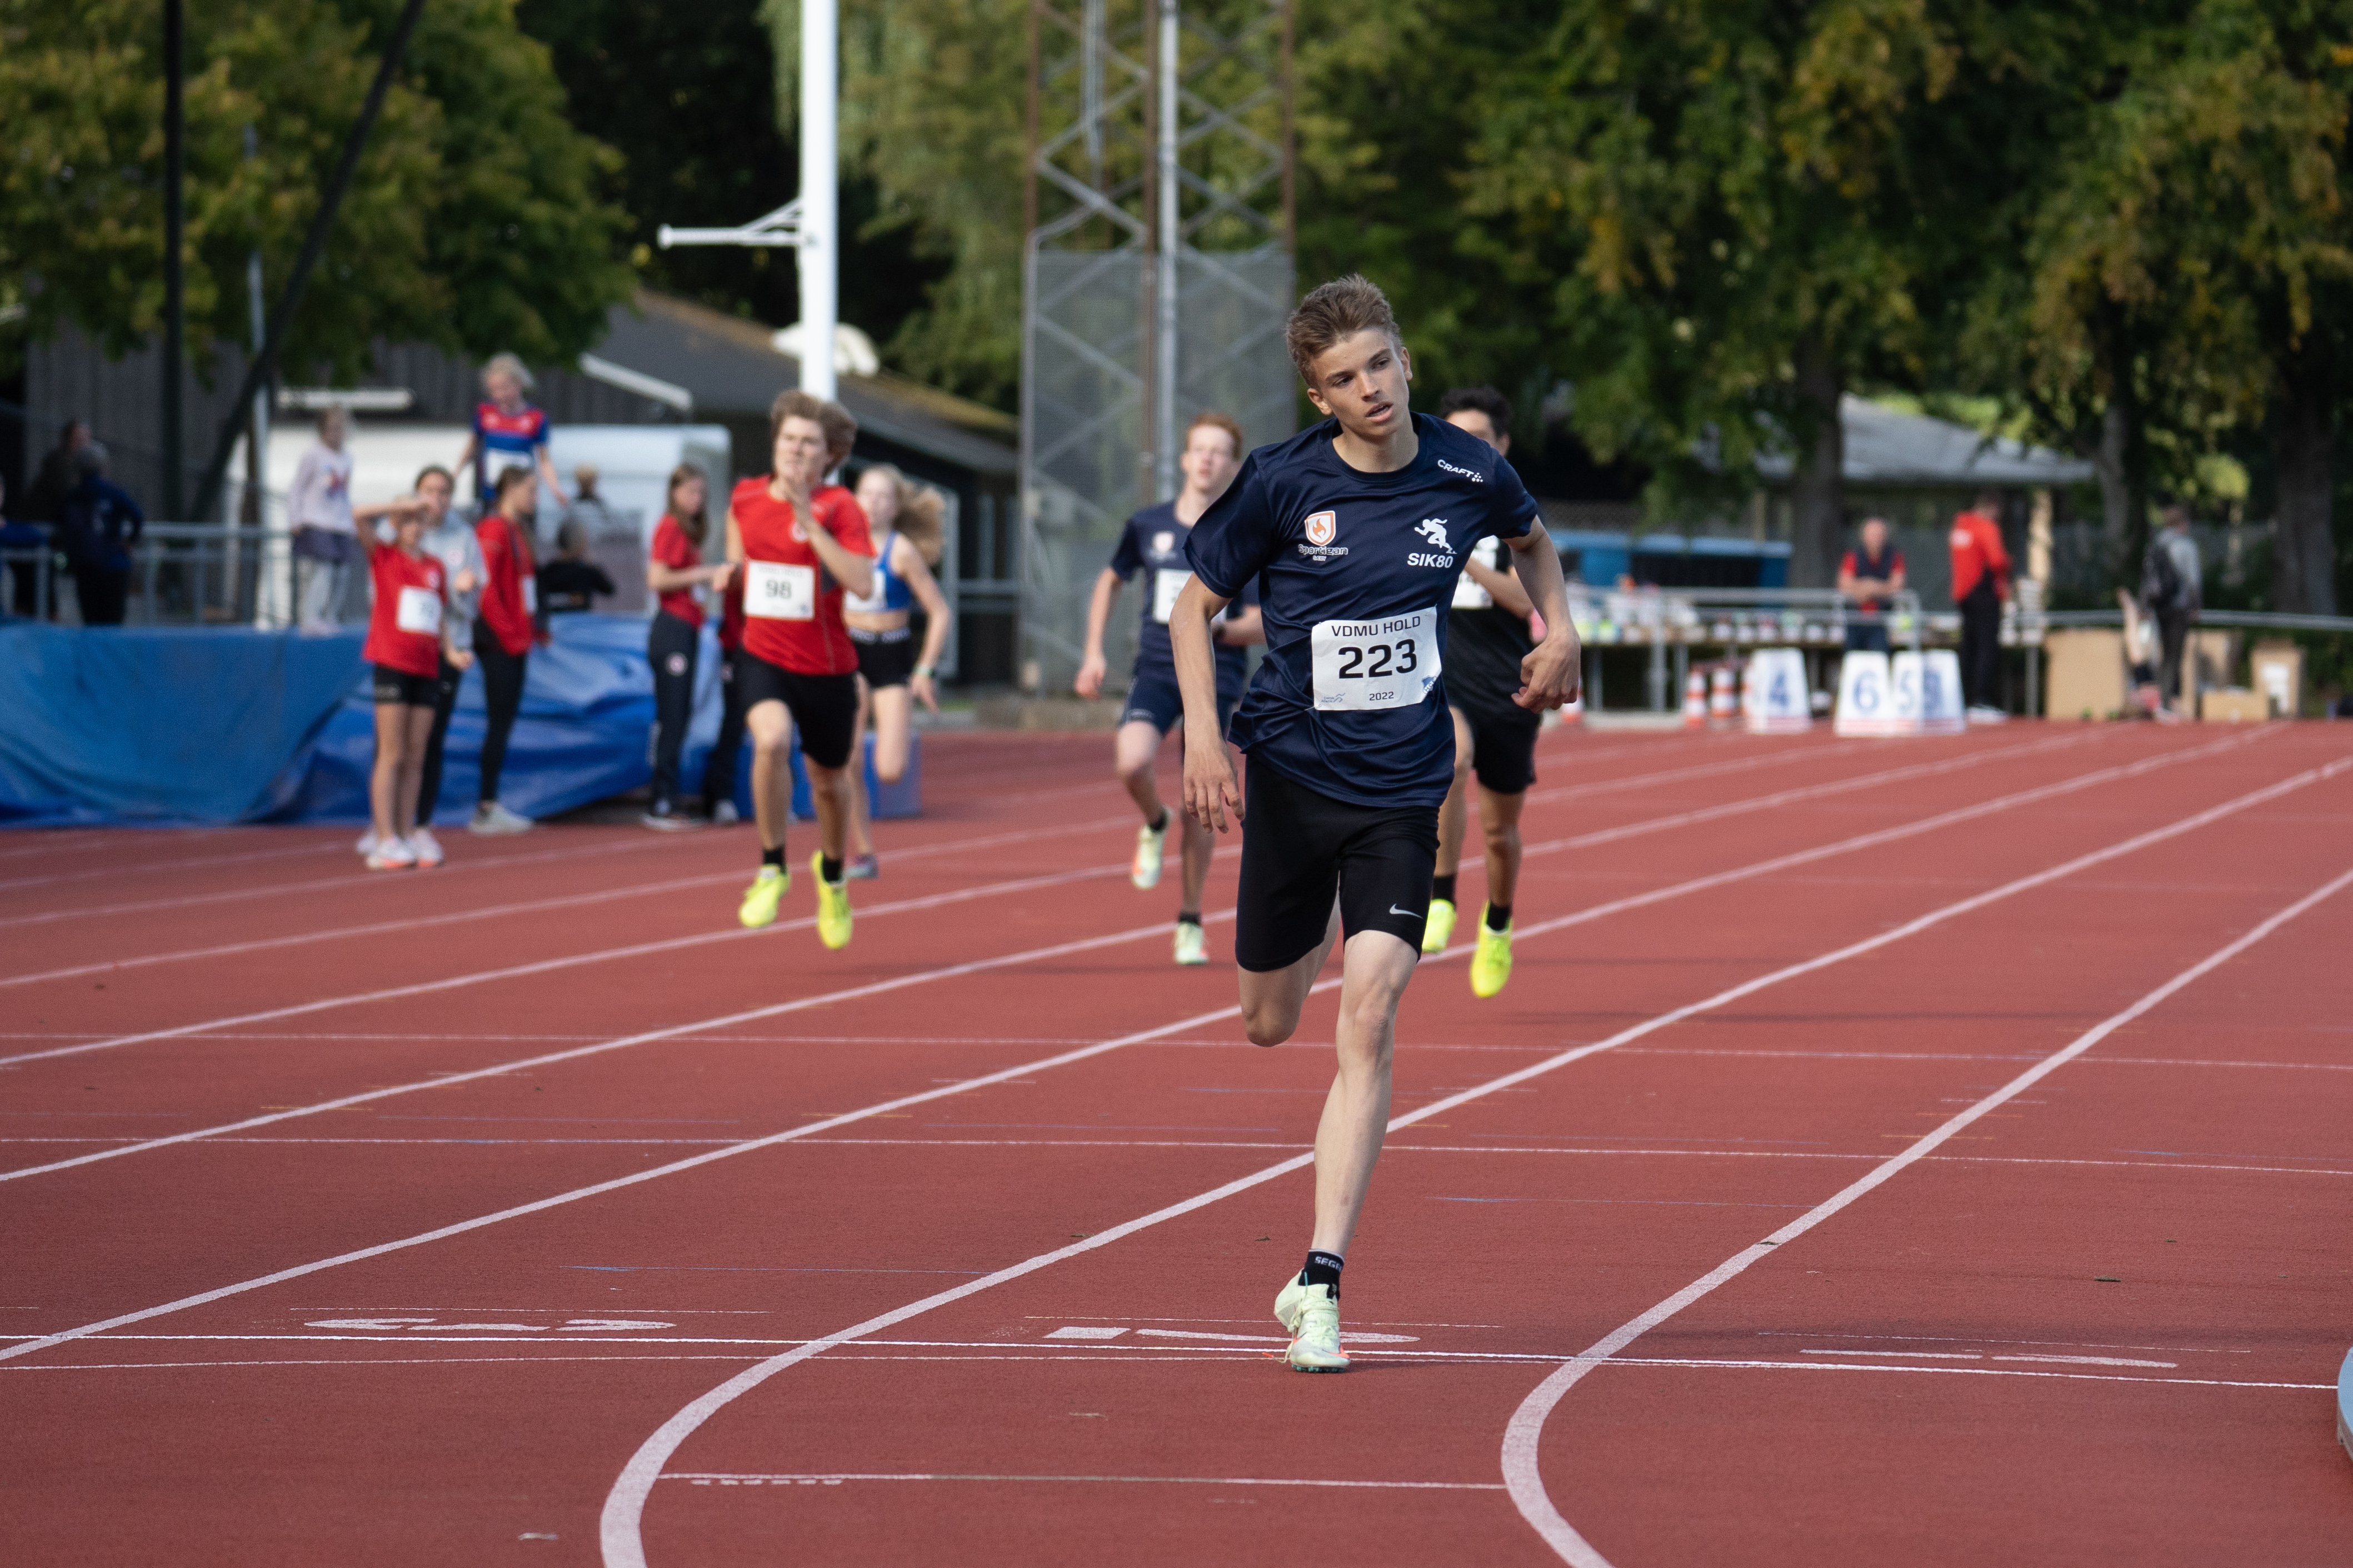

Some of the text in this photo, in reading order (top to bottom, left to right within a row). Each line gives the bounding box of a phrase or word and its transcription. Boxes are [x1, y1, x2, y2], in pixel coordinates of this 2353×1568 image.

[1437, 459, 1474, 478] CRAFT
[1298, 544, 1348, 555] Sportigan
[1407, 553, 1453, 568] SIK80
[766, 579, 792, 599] 98
[1331, 615, 1421, 637] VDMU HOLD
[1338, 638, 1417, 679] 223
[1369, 691, 1394, 701] 2022
[1851, 669, 1881, 715] 6
